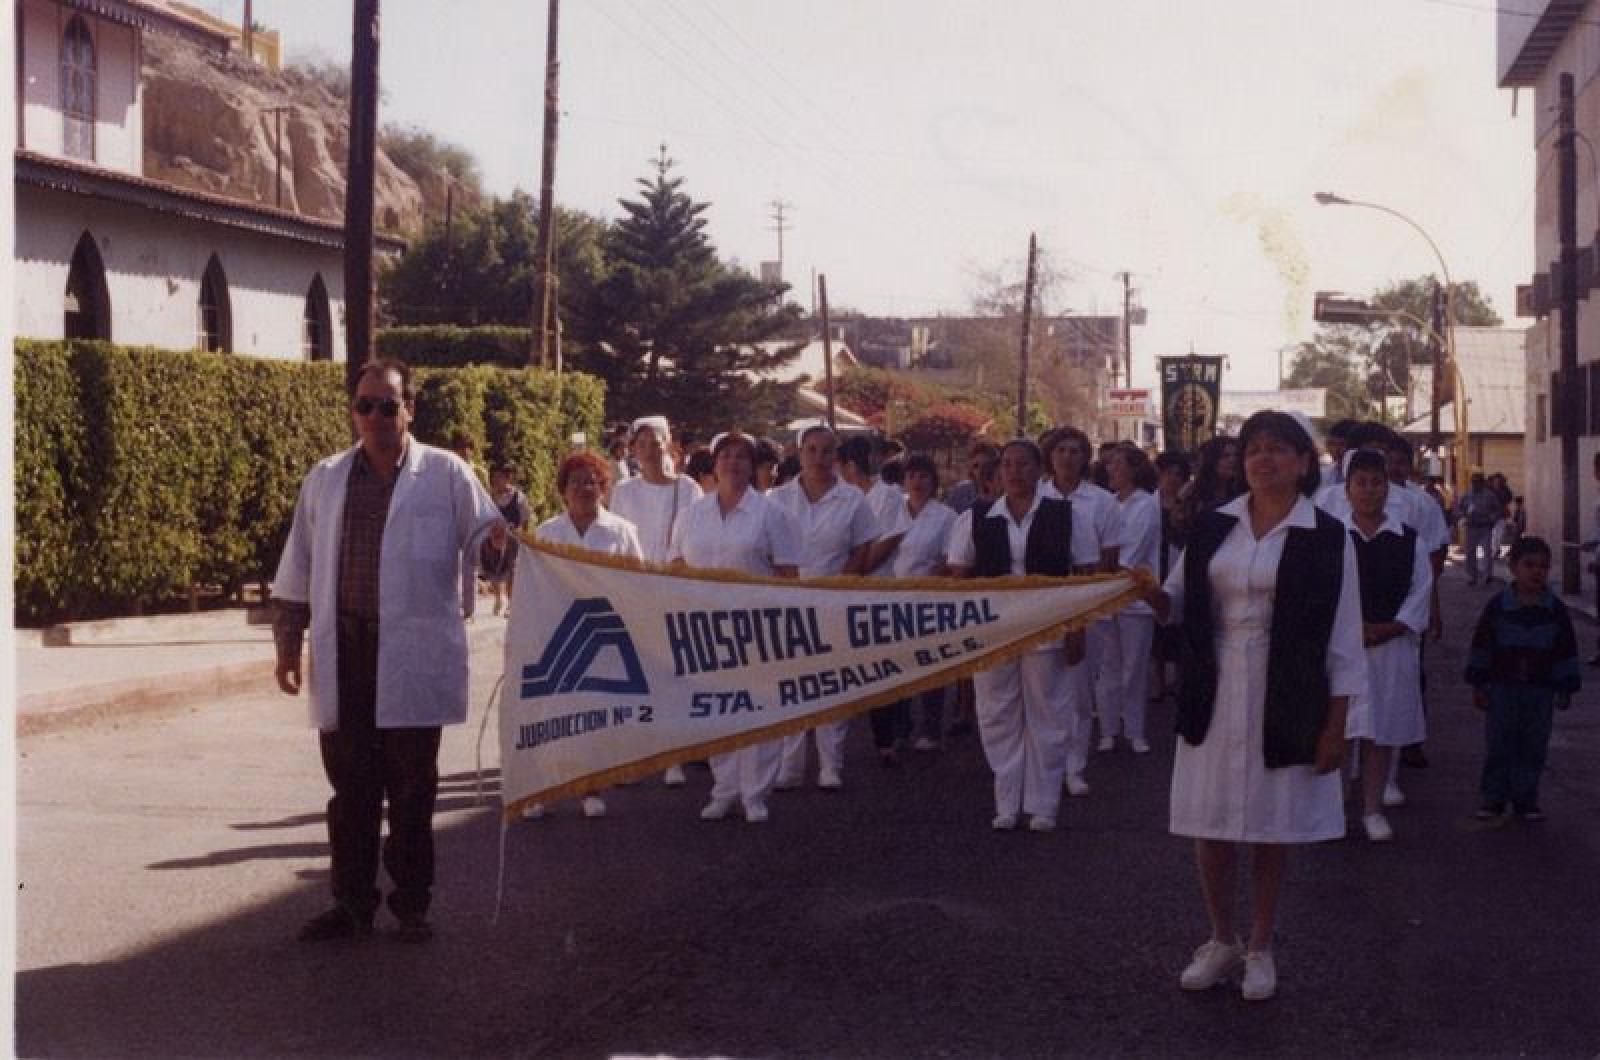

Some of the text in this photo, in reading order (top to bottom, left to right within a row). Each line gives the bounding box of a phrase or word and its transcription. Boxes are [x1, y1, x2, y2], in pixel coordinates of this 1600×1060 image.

[665, 597, 999, 676] HOSPITAL GENERAL
[638, 704, 653, 723] 2
[689, 689, 764, 718] STA.
[778, 658, 902, 706] ROSALIA
